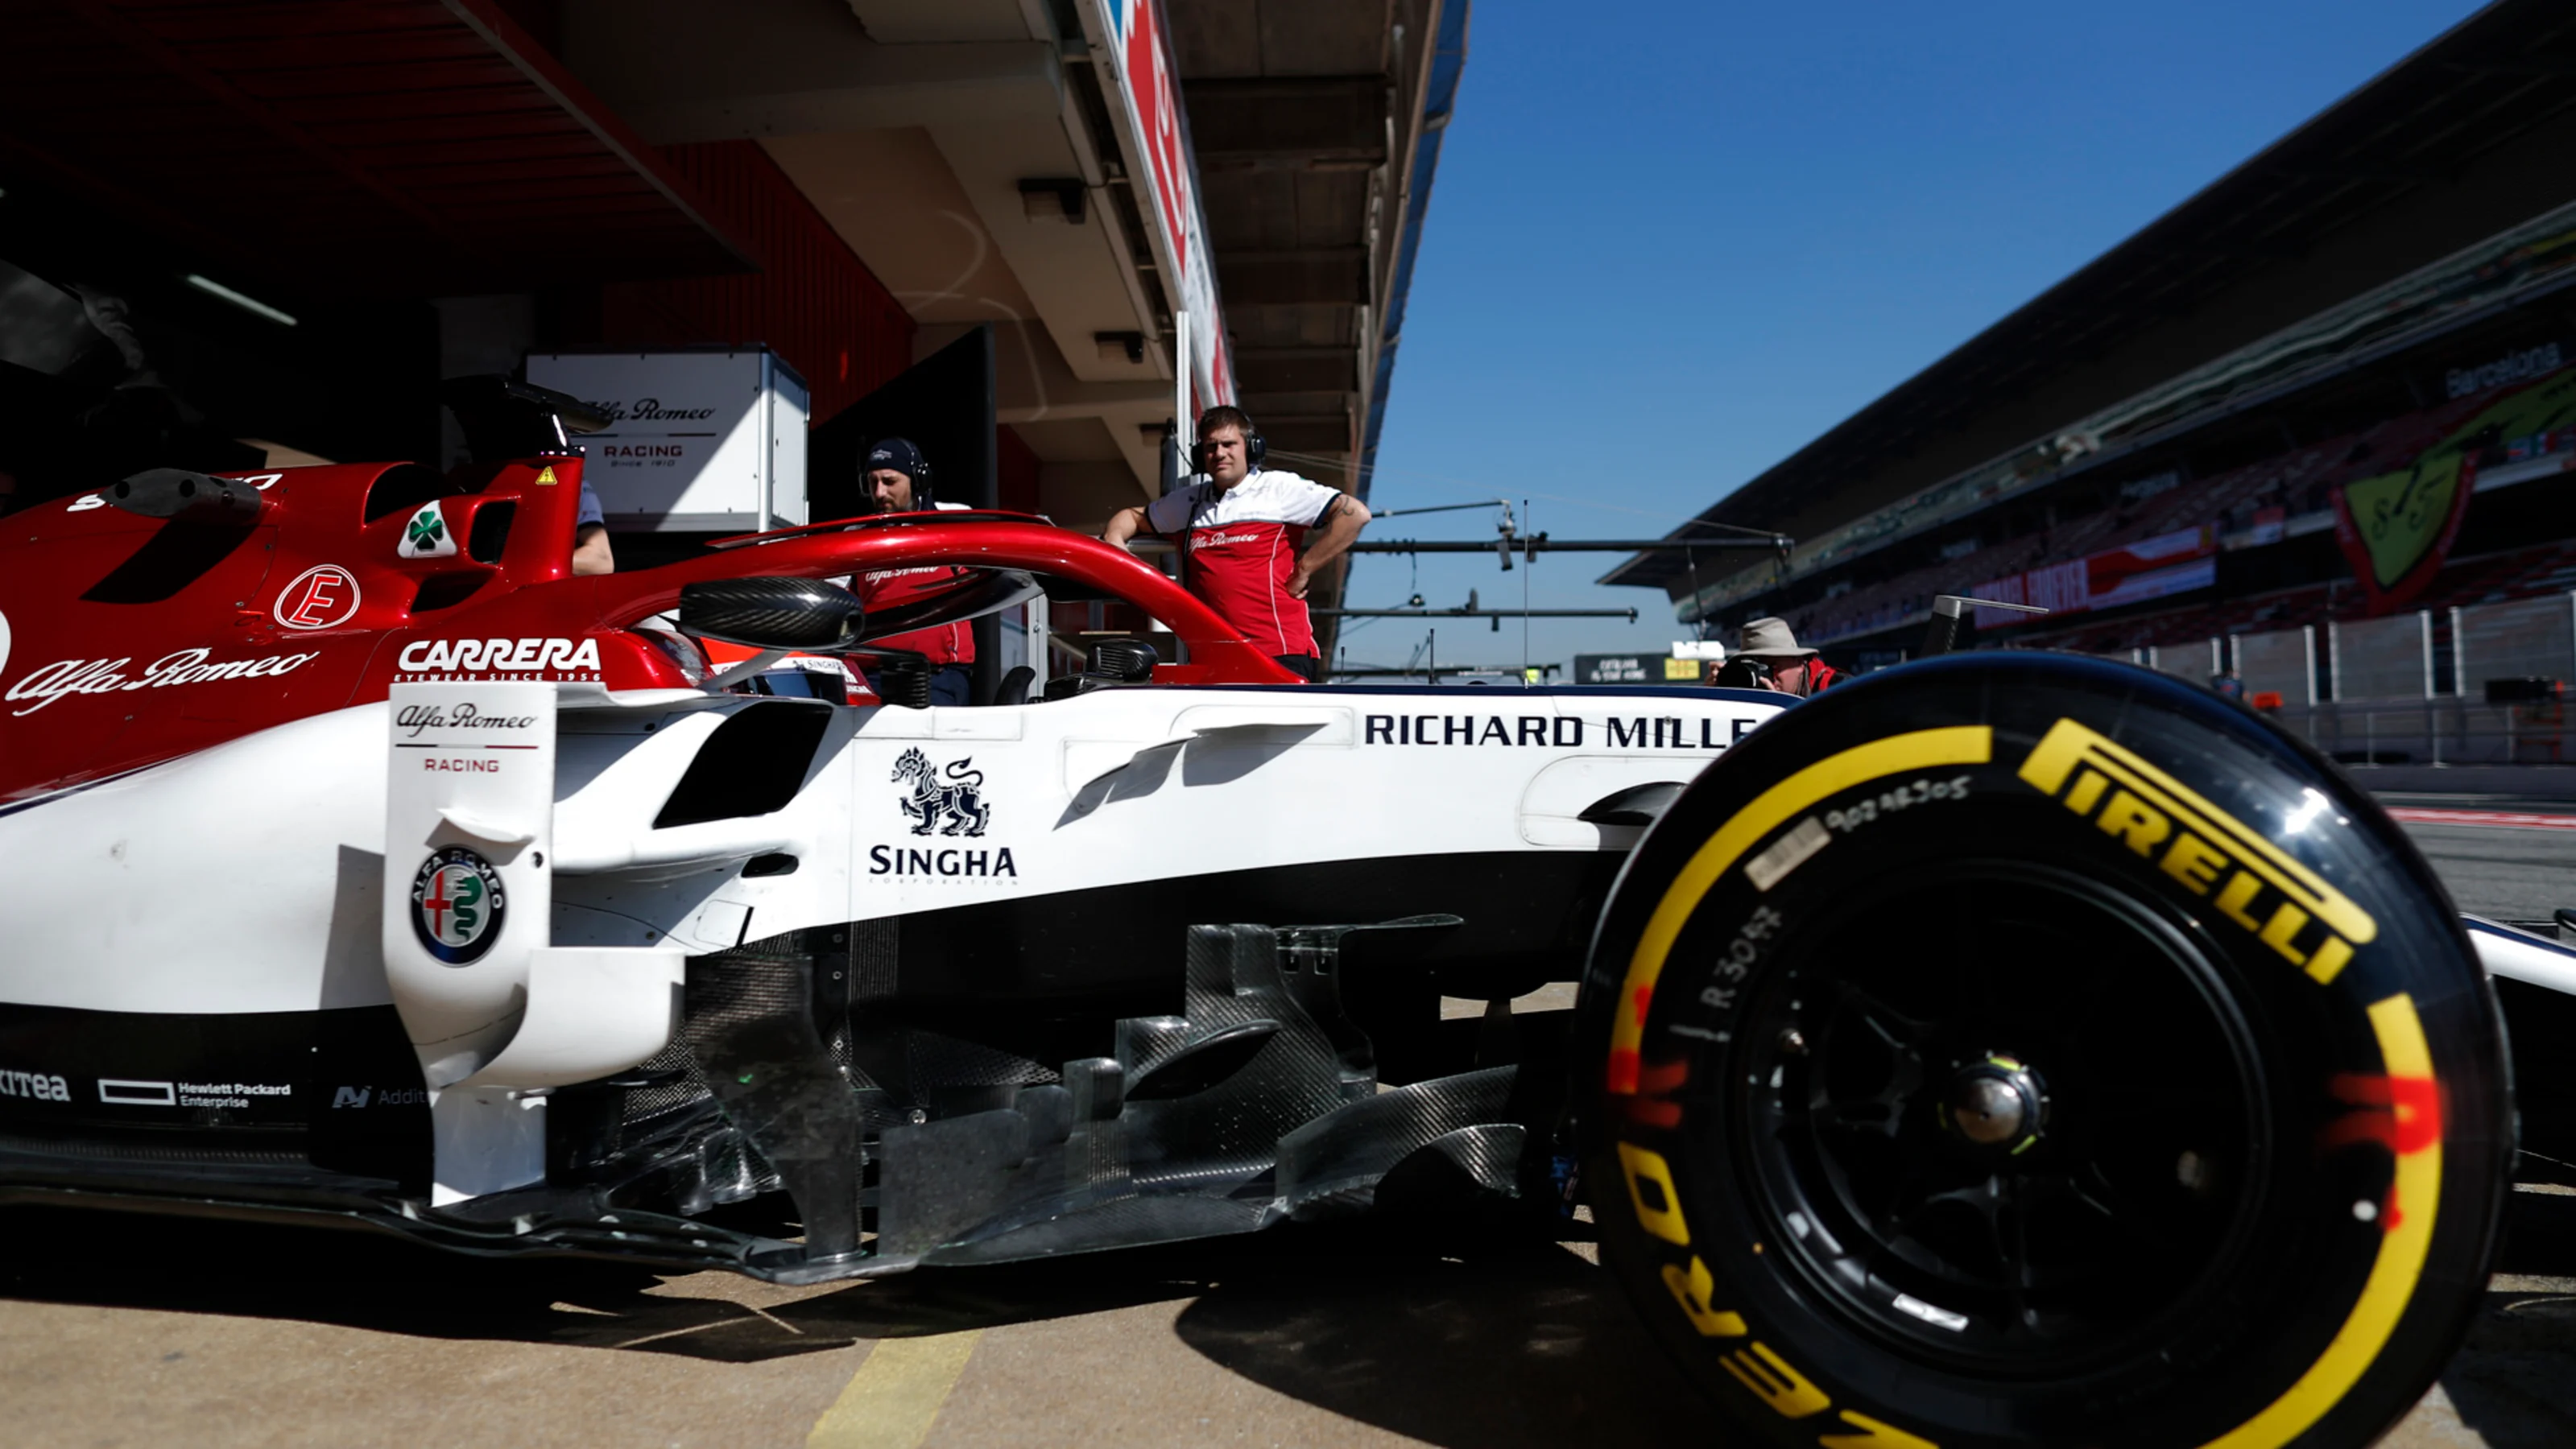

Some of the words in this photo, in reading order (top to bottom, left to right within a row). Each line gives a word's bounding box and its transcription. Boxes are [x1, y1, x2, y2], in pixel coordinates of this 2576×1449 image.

[630, 398, 717, 421] Romeo
[605, 445, 683, 457] RACING
[1208, 531, 1259, 547] Romeo
[290, 573, 341, 626] E
[398, 638, 602, 671] CARRERA
[5, 657, 131, 716] Alfa
[122, 647, 320, 691] Romeo
[394, 673, 477, 682] EYEWEAR
[490, 673, 544, 681] SINCE
[557, 673, 602, 681] 1956
[397, 704, 445, 737] Alfa
[446, 703, 538, 729] Romeo
[1365, 715, 1584, 746] RICHARD
[424, 759, 499, 772] RACING
[869, 844, 1018, 877] SINGHA
[2016, 716, 2378, 985] PIRELLI
[413, 856, 444, 903] ALFA
[178, 1082, 233, 1094] Hewlett
[234, 1084, 292, 1096] Packard
[180, 1096, 249, 1108] Enterprise
